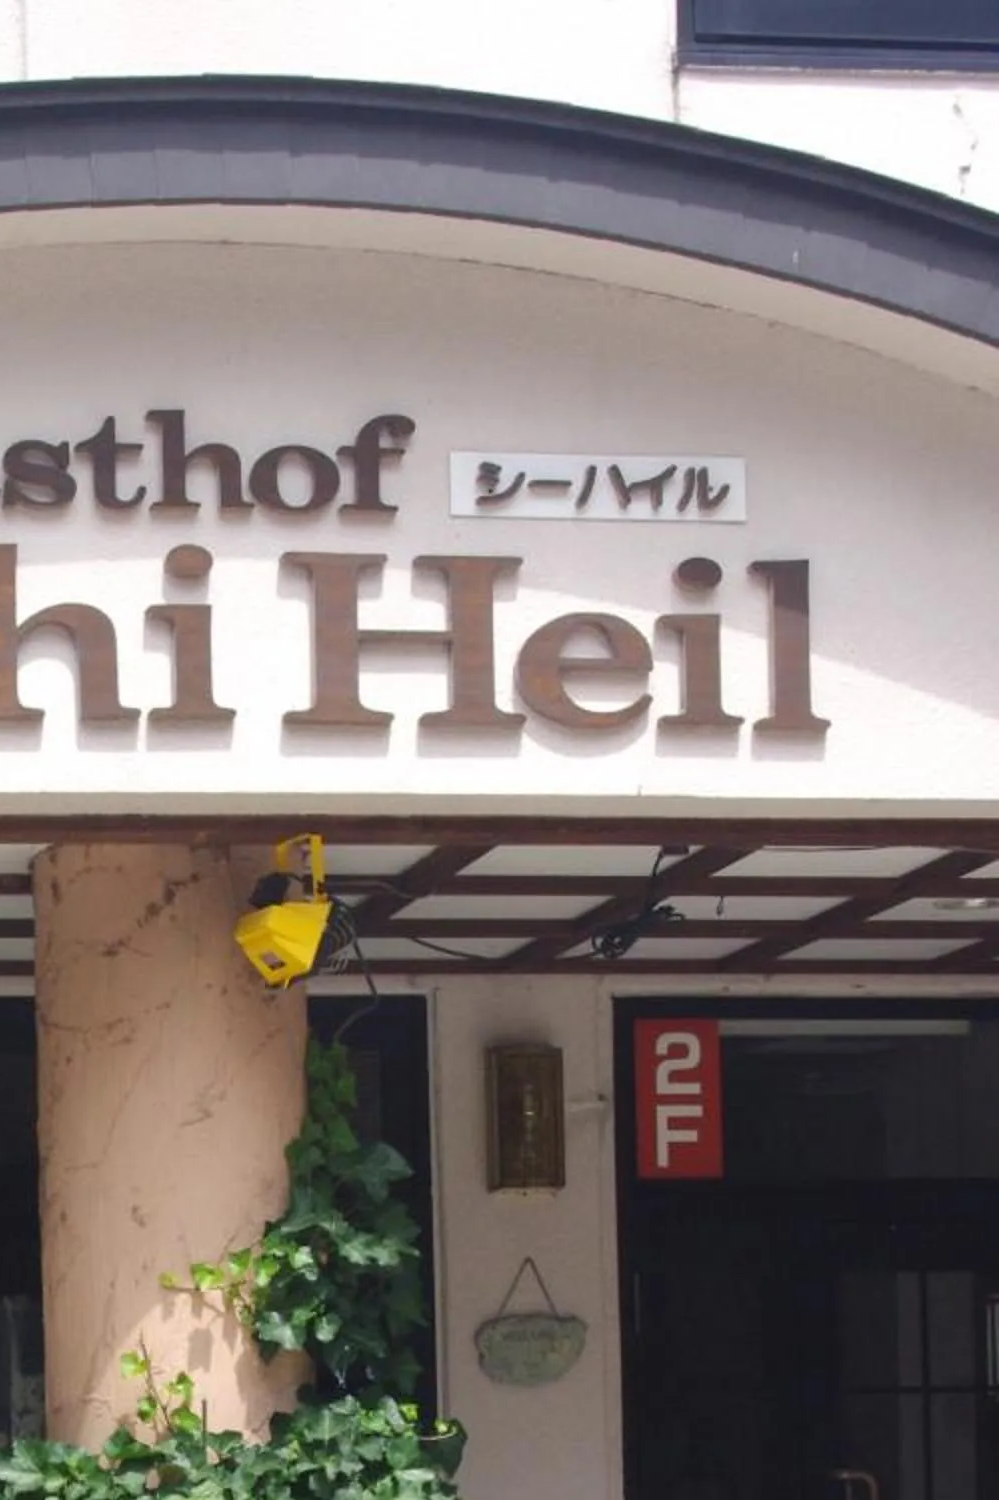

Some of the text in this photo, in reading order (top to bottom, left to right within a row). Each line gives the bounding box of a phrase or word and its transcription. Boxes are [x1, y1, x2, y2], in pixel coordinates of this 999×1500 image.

[473, 458, 731, 513] シーハイル
[655, 1031, 704, 1169] 2F
